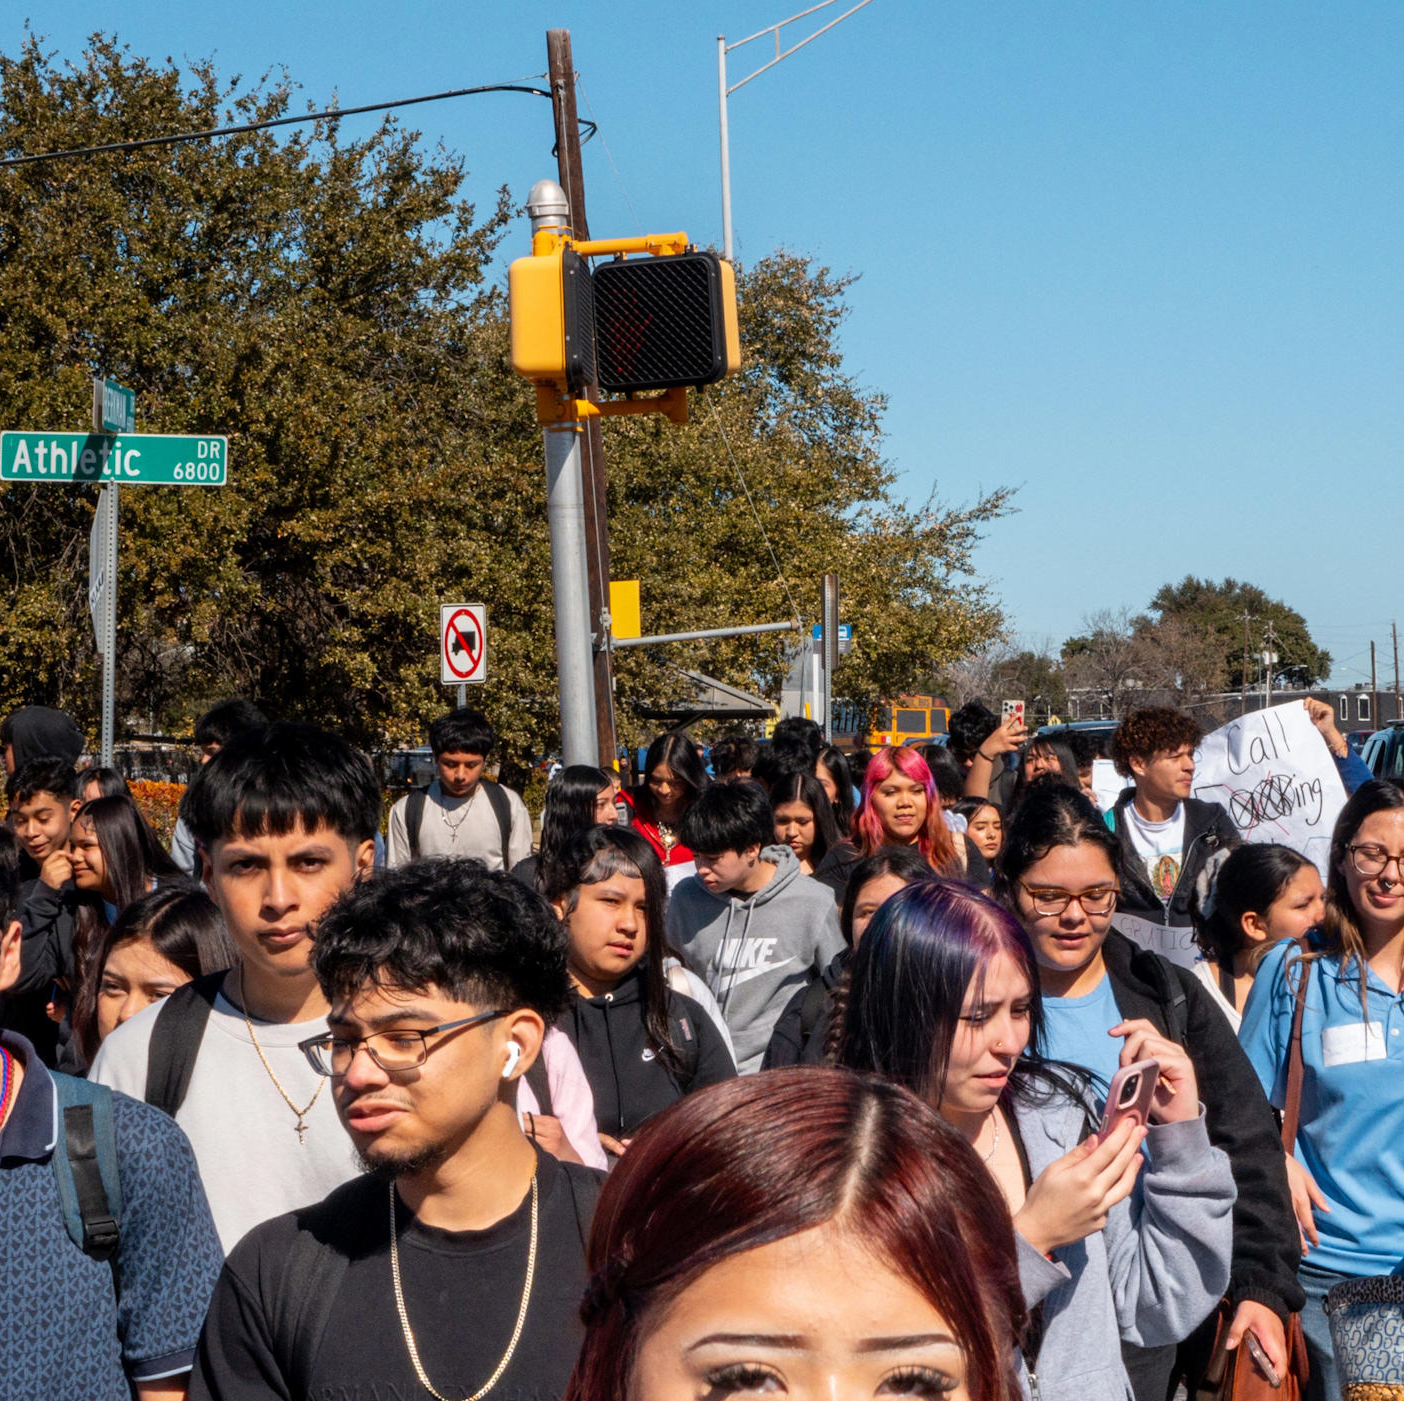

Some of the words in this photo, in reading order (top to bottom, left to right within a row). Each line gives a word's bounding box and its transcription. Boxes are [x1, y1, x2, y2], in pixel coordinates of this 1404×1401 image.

[11, 438, 141, 476] Athletic
[197, 441, 221, 458] DR
[173, 462, 220, 480] 6800
[1226, 711, 1291, 775] Call
[715, 938, 777, 968] NIKE
